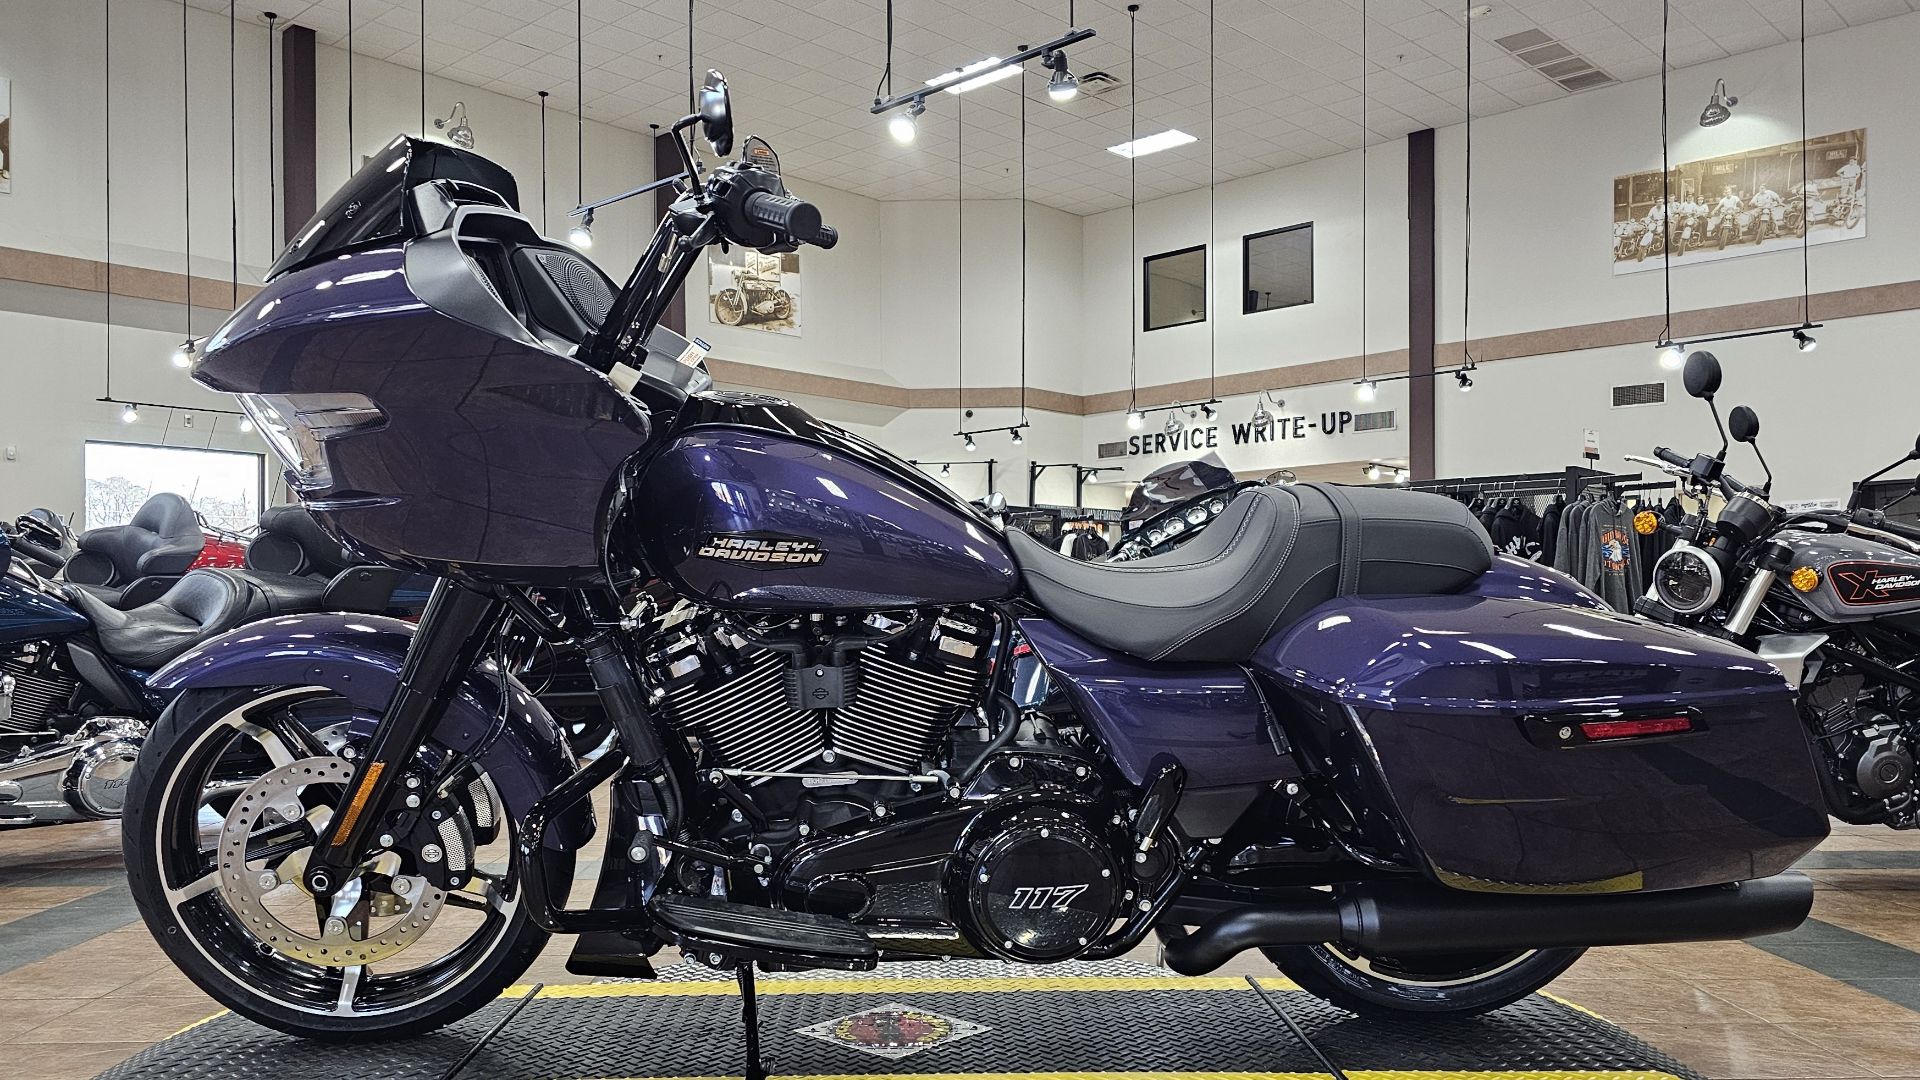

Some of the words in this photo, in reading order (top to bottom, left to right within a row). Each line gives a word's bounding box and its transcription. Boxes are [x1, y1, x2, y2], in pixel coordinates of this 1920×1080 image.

[1128, 426, 1218, 456] SERVICE
[1231, 411, 1353, 444] WRITE-UP
[712, 537, 816, 551] HARLEY-
[698, 546, 823, 563] DAVIDSON
[1871, 574, 1916, 585] HARLEY-
[1008, 883, 1090, 910] 117
